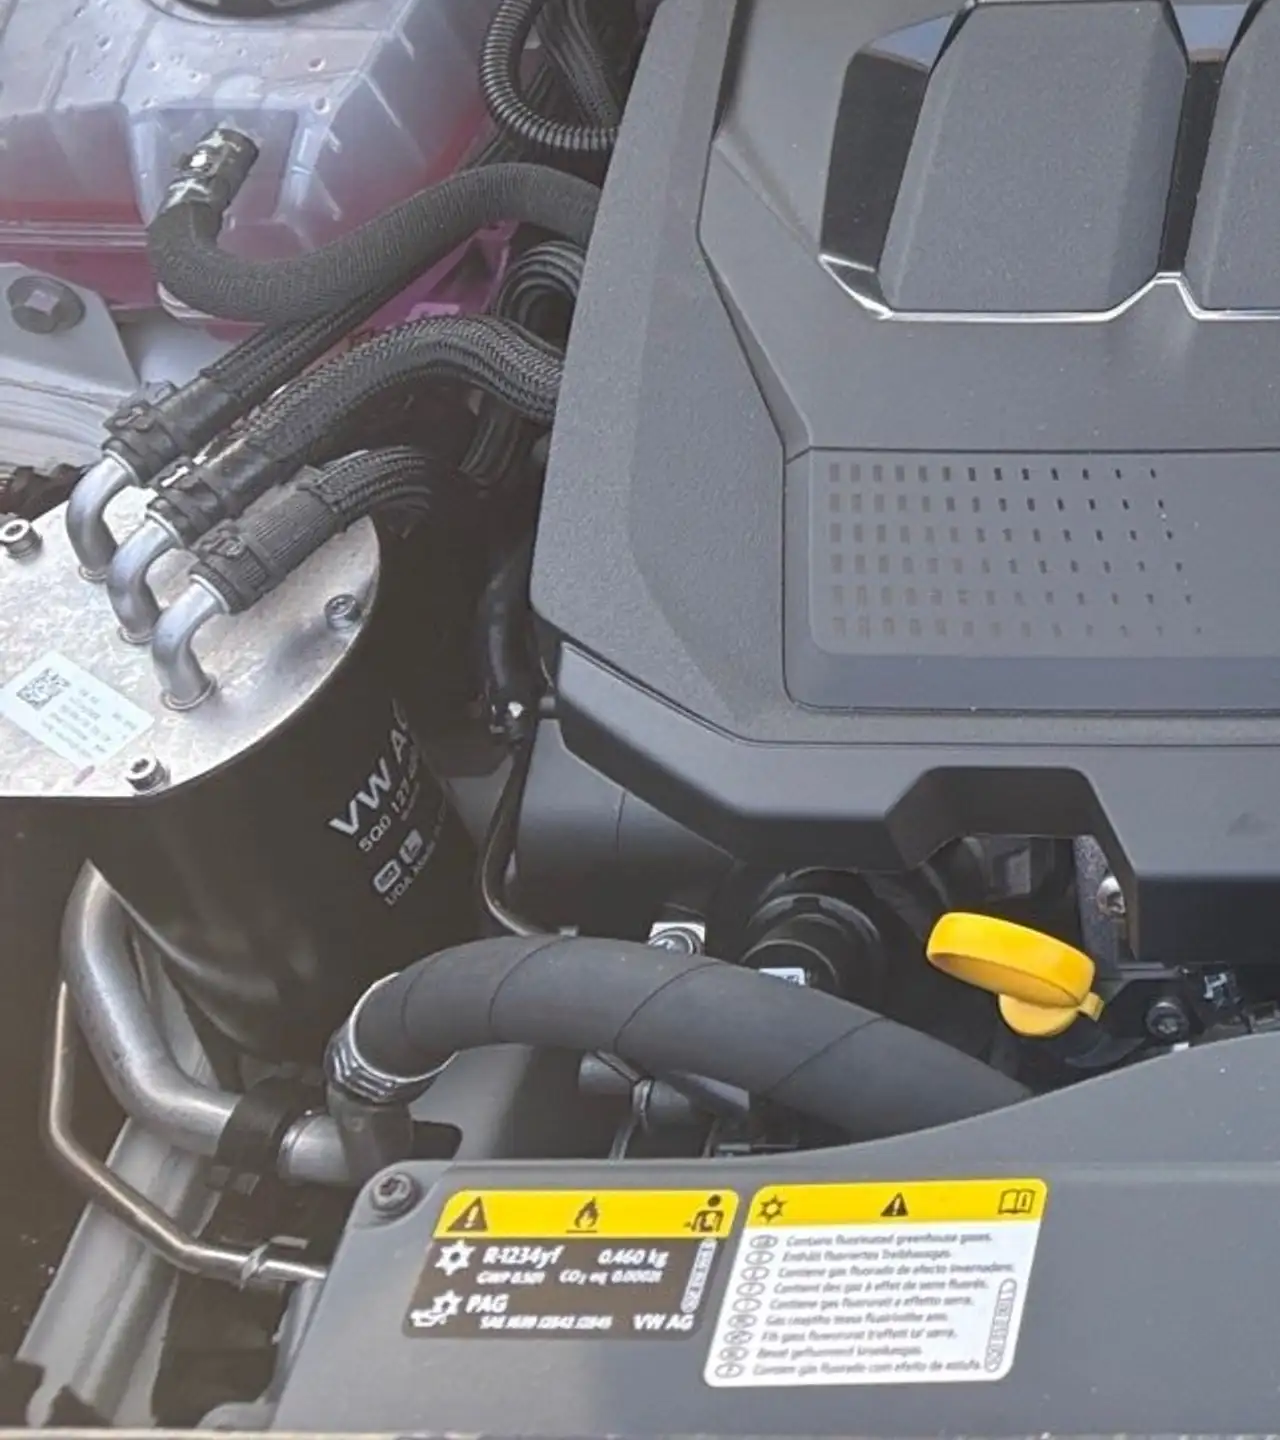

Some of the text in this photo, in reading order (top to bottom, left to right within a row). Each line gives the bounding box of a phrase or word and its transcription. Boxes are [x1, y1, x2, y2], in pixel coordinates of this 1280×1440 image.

[329, 756, 392, 836] VW
[482, 1244, 566, 1269] R-1234yf
[465, 1293, 510, 1313] PAG
[632, 1314, 663, 1331] VW
[664, 1314, 695, 1331] AG
